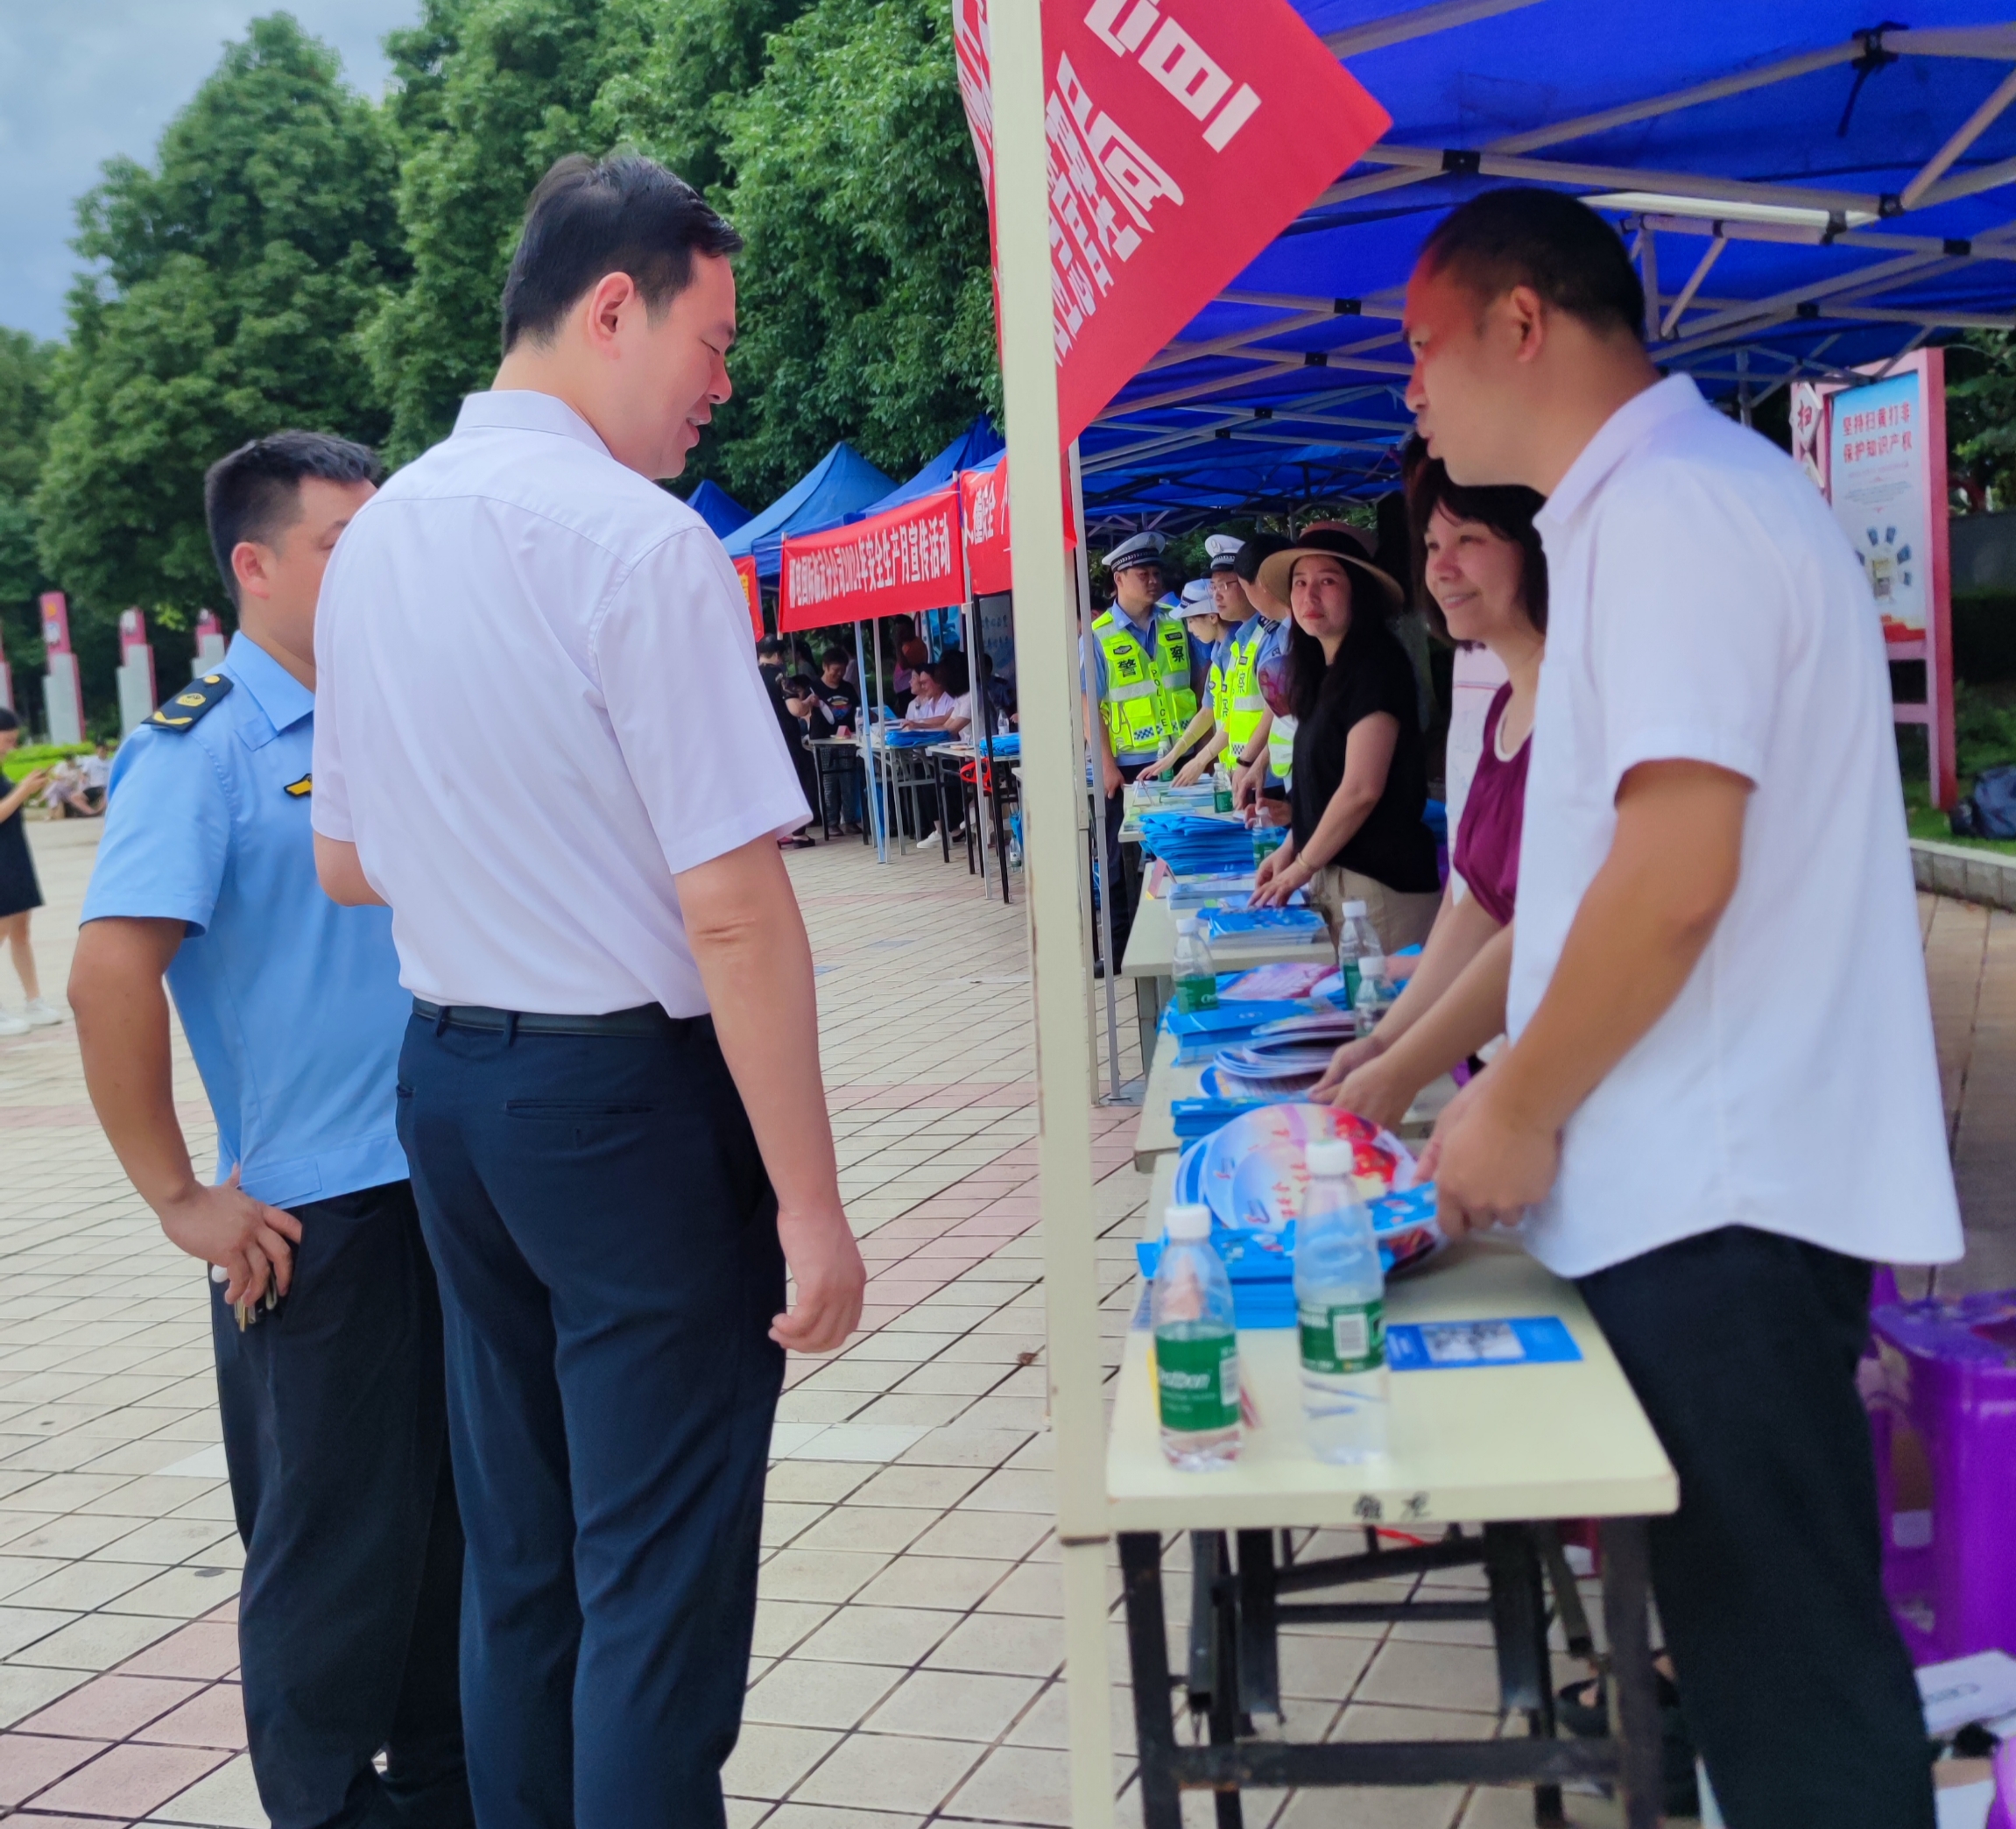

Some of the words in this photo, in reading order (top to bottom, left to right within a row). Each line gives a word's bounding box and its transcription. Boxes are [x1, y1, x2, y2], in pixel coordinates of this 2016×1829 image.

[1843, 400, 1911, 437] 坚持扫黄打非
[1843, 430, 1913, 464] 保护知识产权
[1117, 659, 1138, 677] 警
[1169, 645, 1185, 663] 察
[1152, 669, 1168, 727] POLICE
